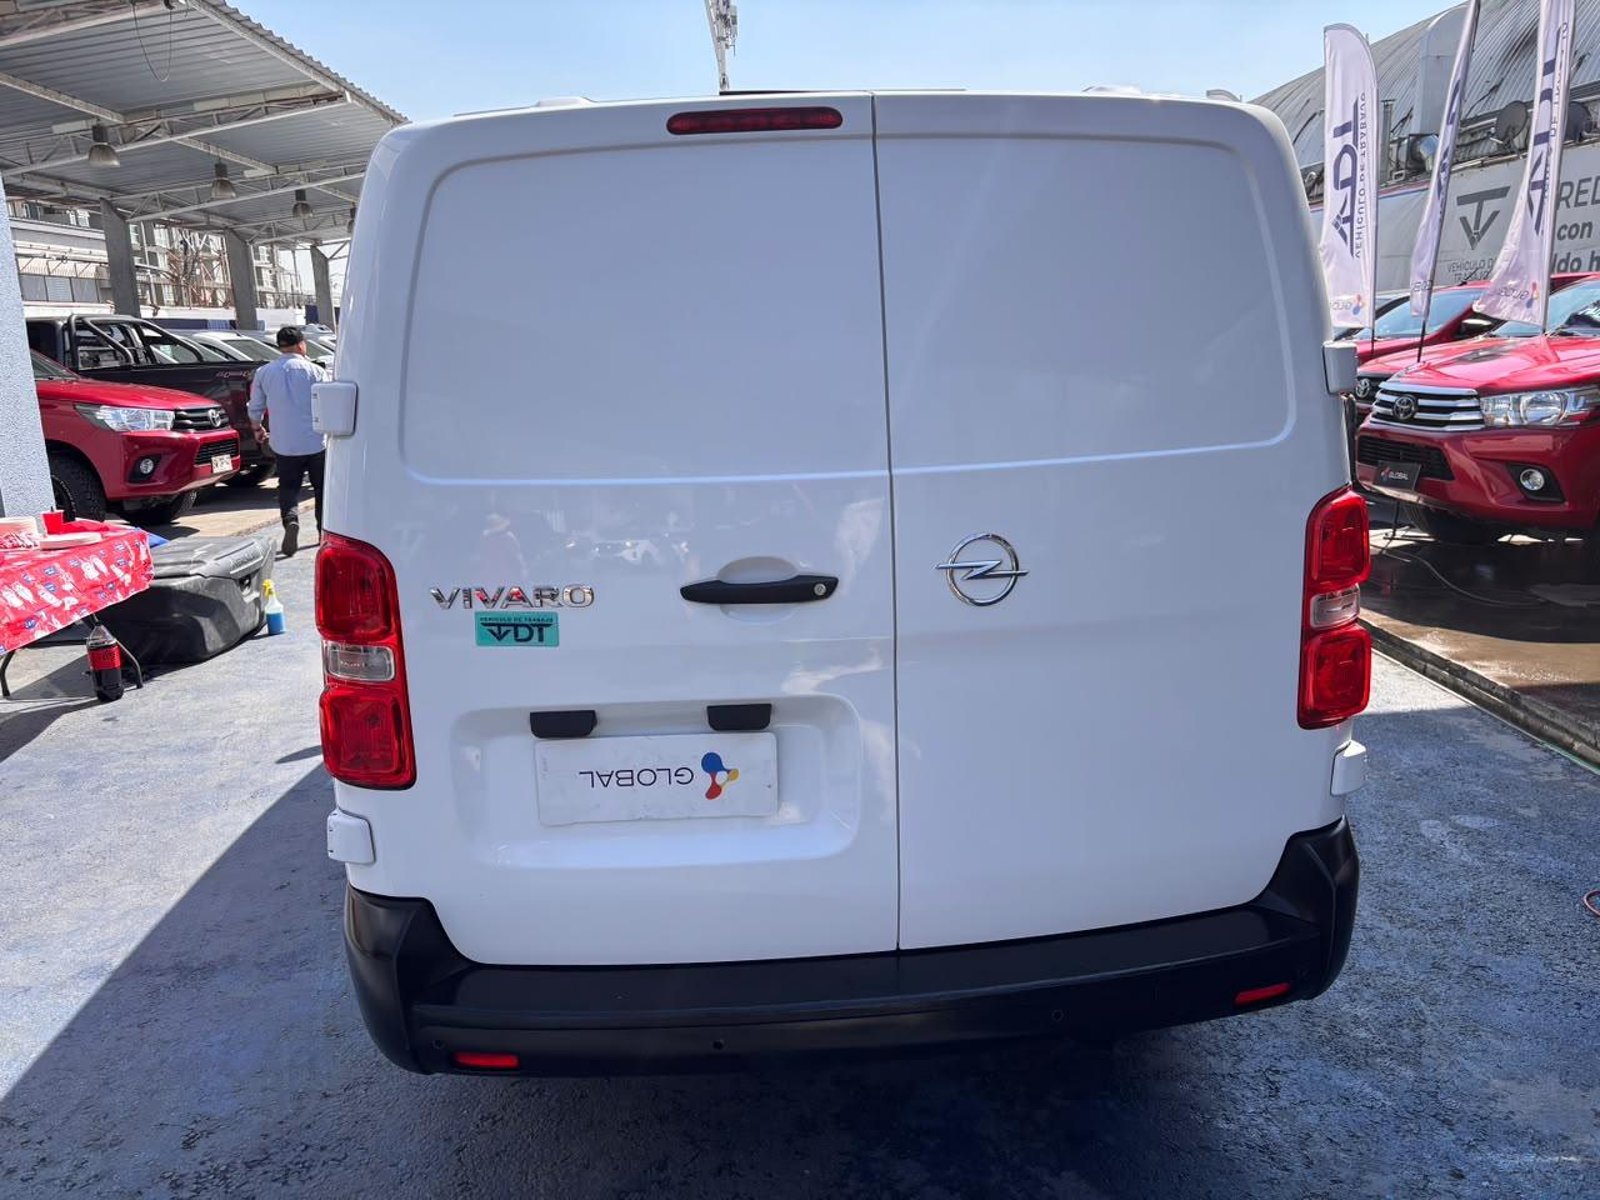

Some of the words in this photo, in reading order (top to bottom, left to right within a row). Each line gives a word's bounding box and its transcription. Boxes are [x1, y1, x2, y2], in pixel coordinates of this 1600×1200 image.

[1557, 221, 1593, 241] con
[429, 584, 595, 610] VIVARO
[578, 767, 695, 789] GLOBAL
